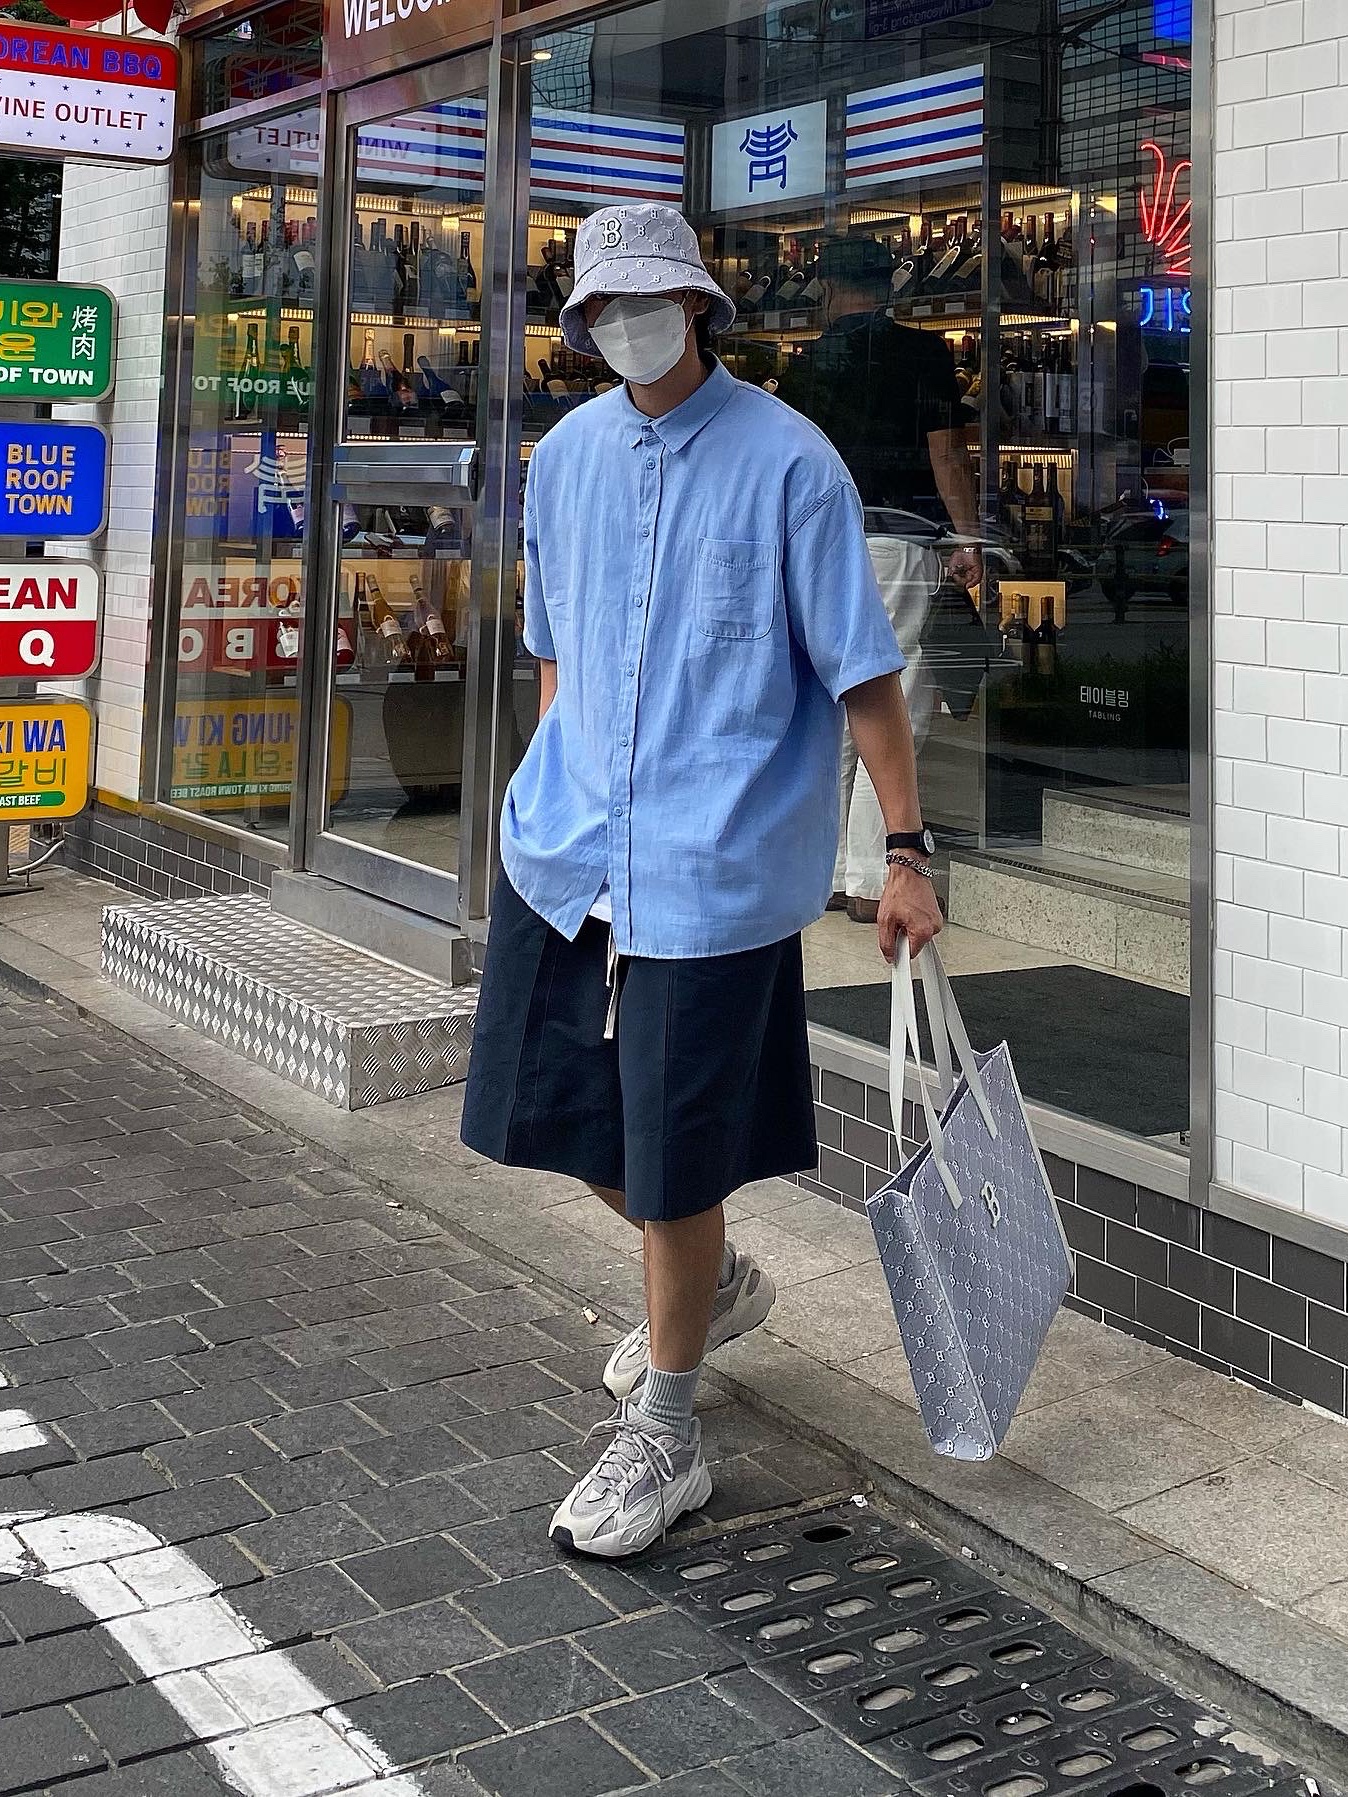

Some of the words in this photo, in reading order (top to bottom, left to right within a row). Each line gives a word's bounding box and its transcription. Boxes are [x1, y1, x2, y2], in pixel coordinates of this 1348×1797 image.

[103, 49, 161, 80] BBQ
[0, 96, 45, 119] INE
[55, 103, 148, 131] OUTLET
[600, 216, 623, 249] B
[71, 305, 98, 361] 烤肉
[29, 367, 94, 386] TOWN
[7, 443, 76, 466] BLUE
[5, 468, 75, 491] ROOF
[5, 493, 73, 516] TOWN
[19, 629, 55, 668] Q
[1080, 685, 1129, 708] 테이블링
[1088, 710, 1121, 721] TABLING
[23, 719, 66, 753] WA
[18, 794, 41, 806] BEEF
